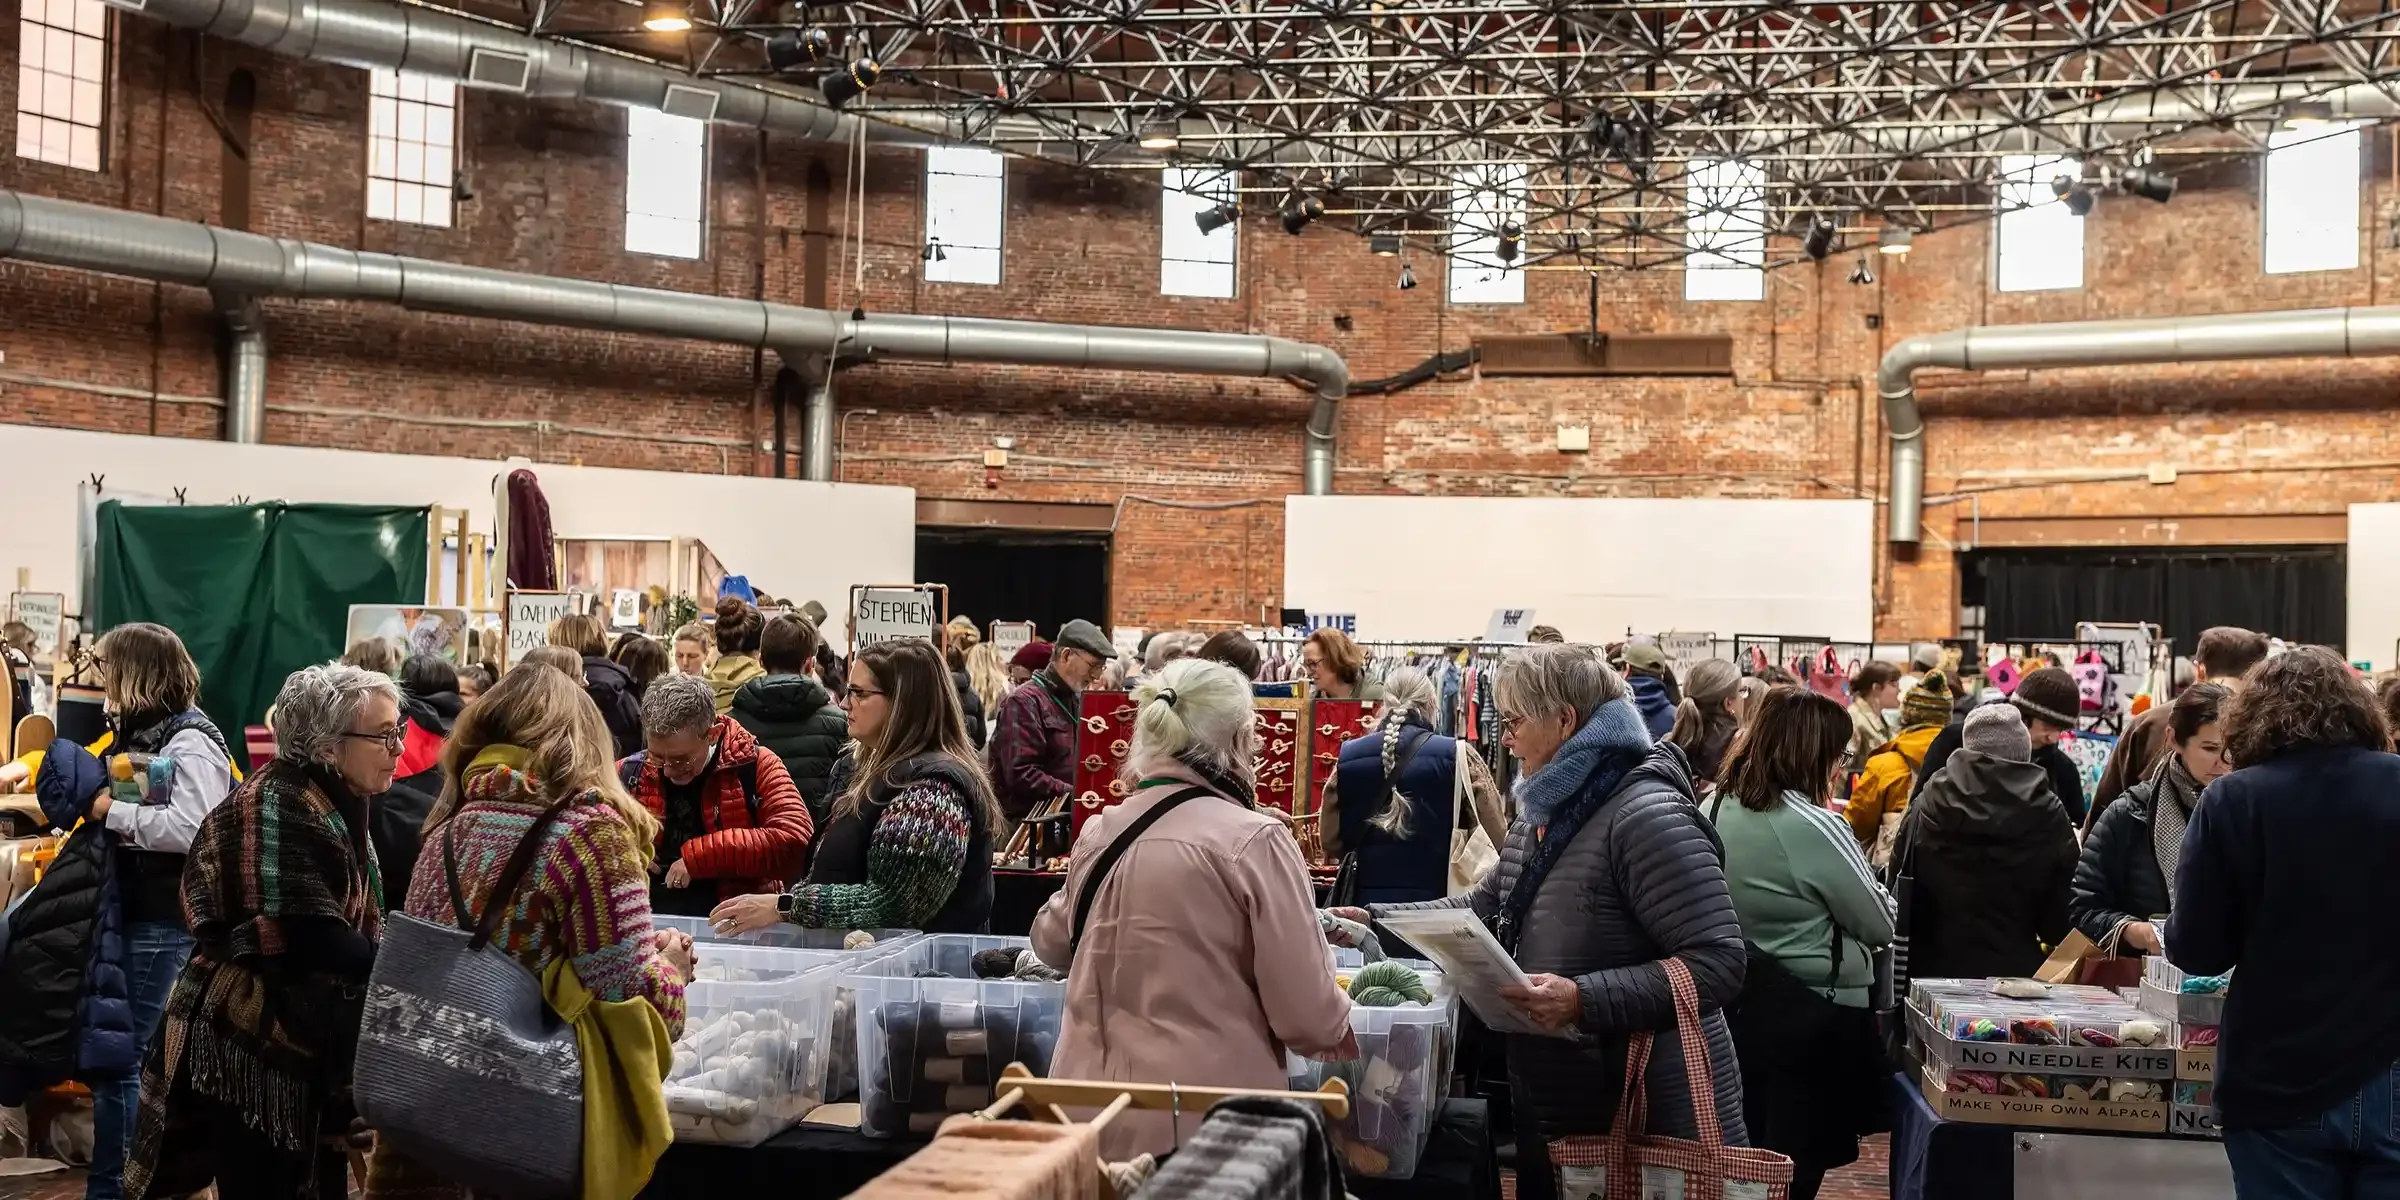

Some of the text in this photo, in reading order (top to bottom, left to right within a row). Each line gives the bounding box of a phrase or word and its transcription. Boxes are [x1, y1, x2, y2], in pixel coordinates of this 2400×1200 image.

[859, 599, 932, 626] STEPHEN
[511, 629, 548, 649] BASK
[2008, 1051, 2104, 1069] NEEDLE
[2116, 1054, 2168, 1070] KITS
[2187, 1060, 2213, 1072] MA
[1949, 1097, 2161, 1119] MAKE YOUR OWN ALPACA
